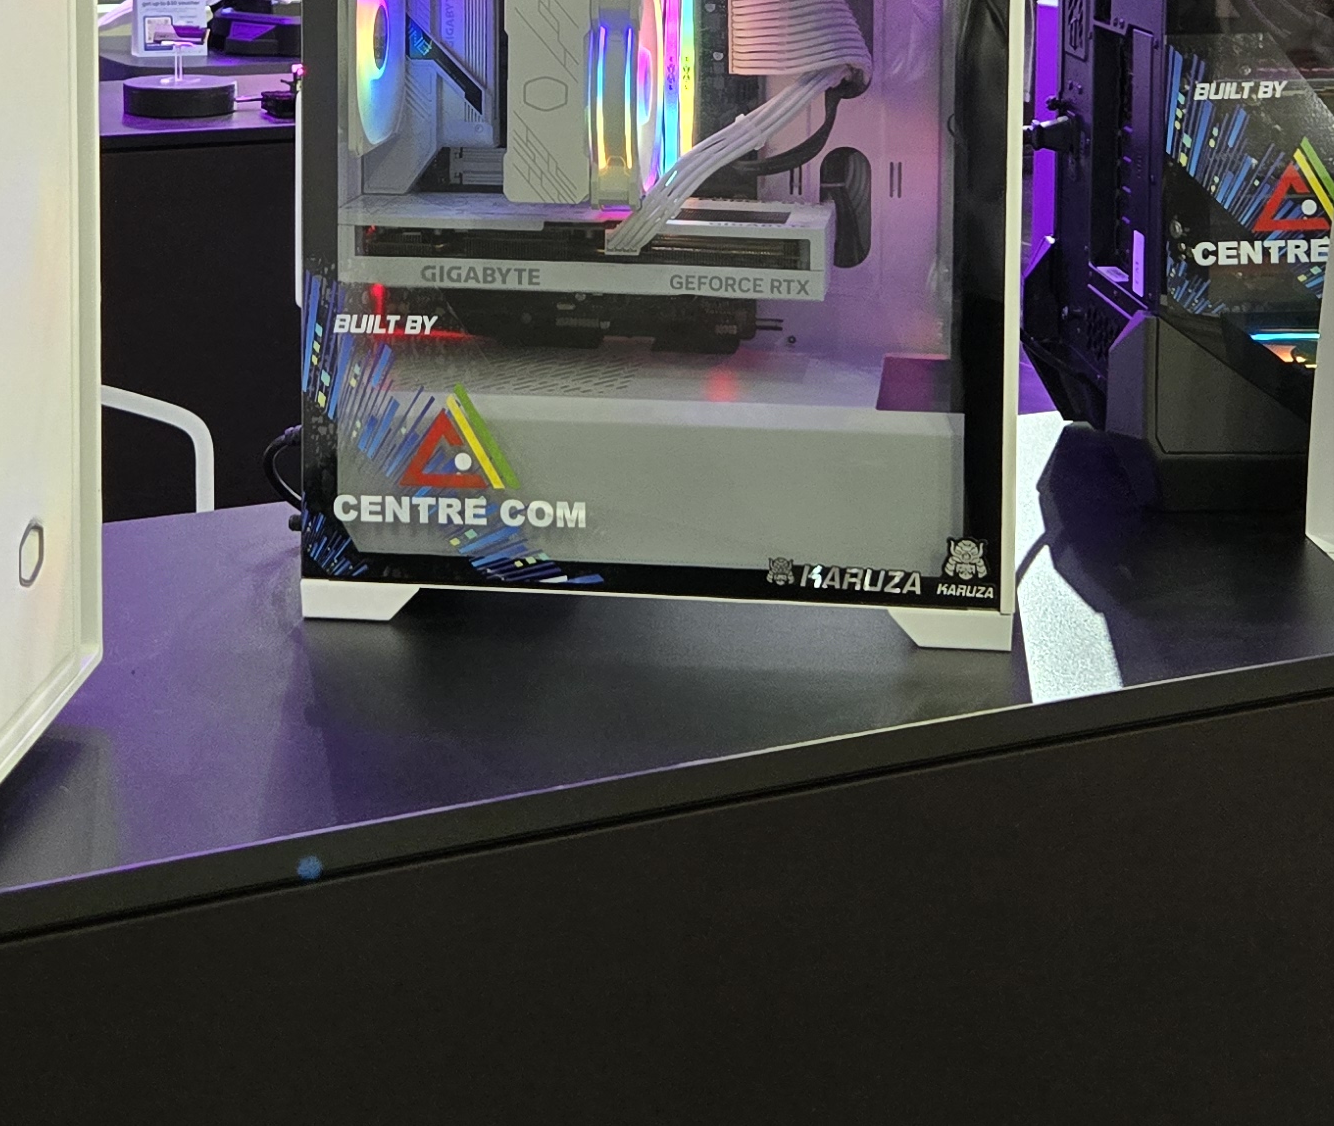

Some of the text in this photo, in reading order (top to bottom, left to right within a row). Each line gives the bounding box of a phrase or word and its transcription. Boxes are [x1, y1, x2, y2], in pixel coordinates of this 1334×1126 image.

[1193, 80, 1287, 101] BUILT BY
[1193, 238, 1330, 266] CENTRE
[420, 264, 541, 286] GIGABYTE
[670, 273, 811, 296] GEFORCE RTX
[333, 313, 438, 335] BUILT BY
[333, 493, 586, 528] CENTRE COM
[800, 564, 922, 594] KARUZA
[936, 581, 994, 599] KARUZA
